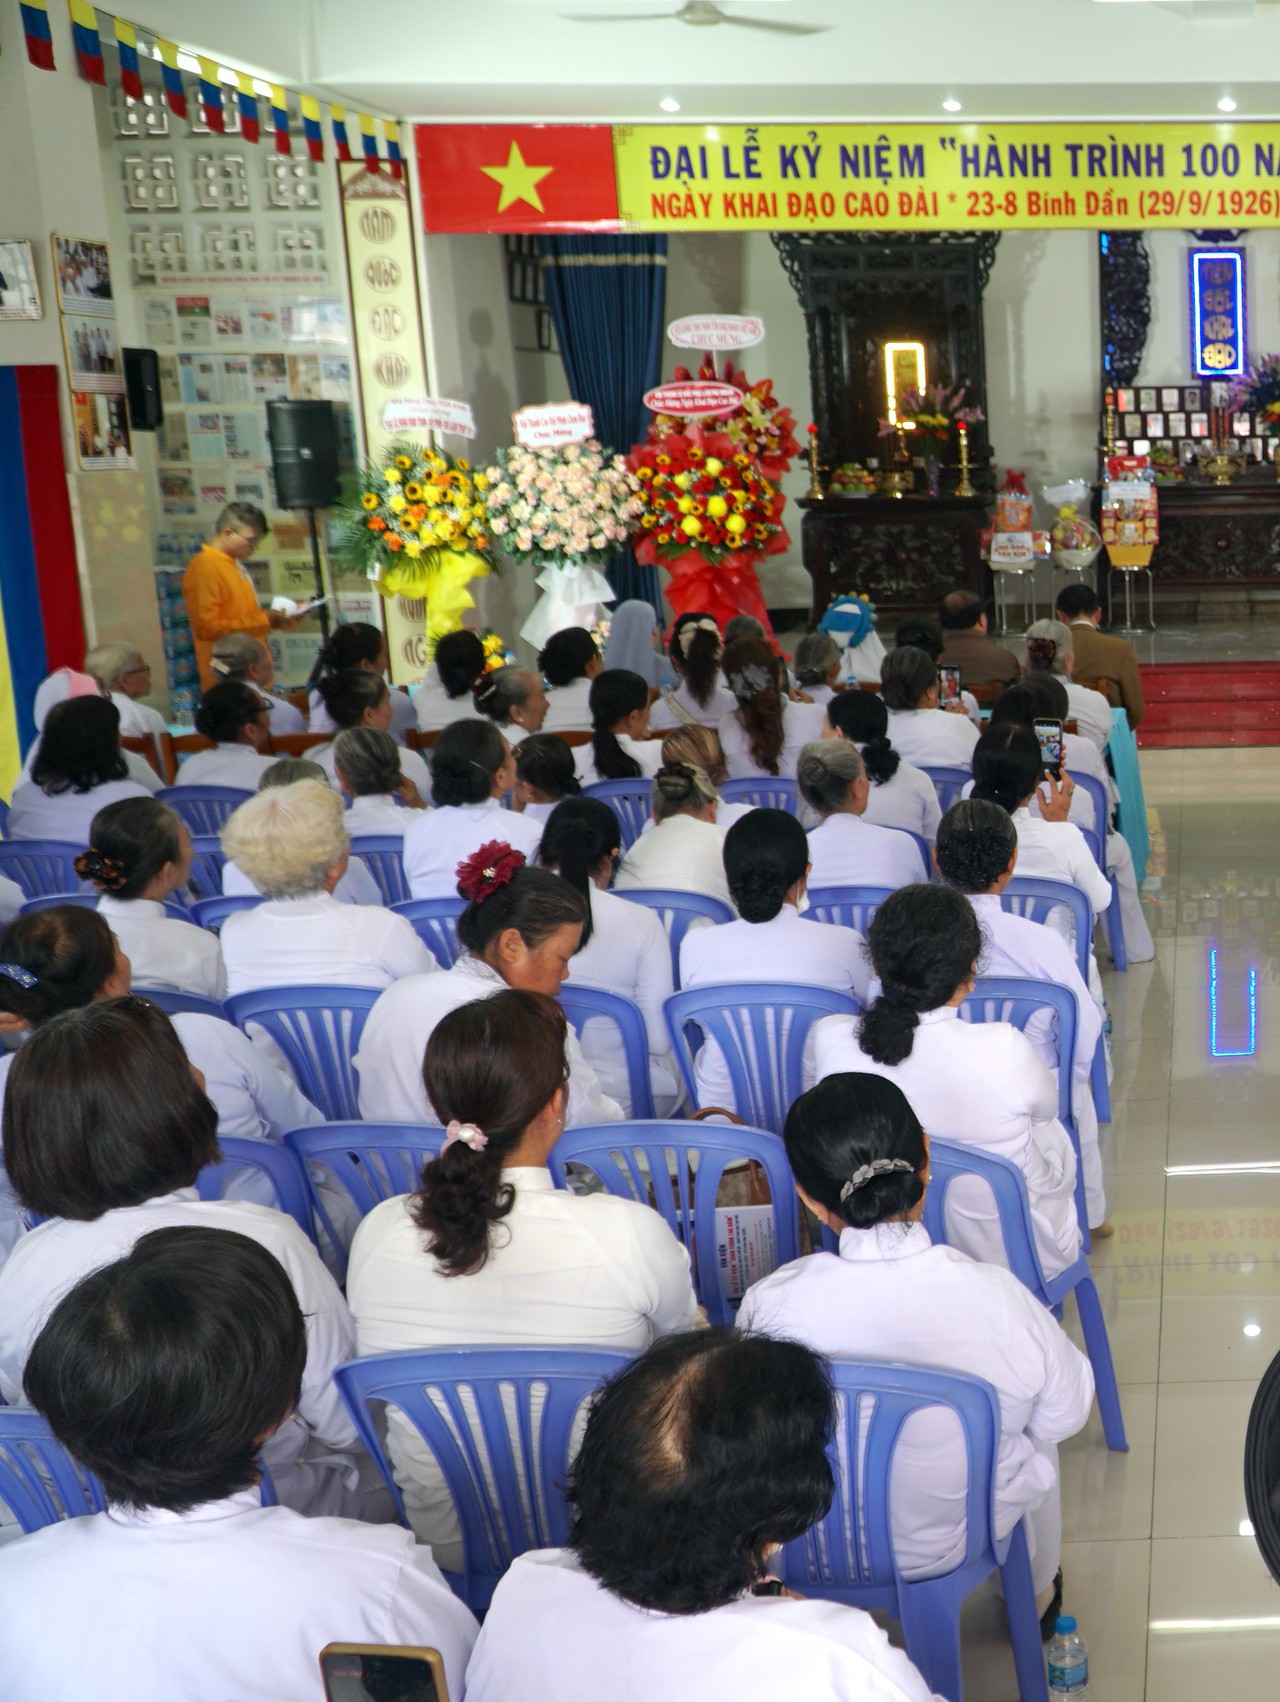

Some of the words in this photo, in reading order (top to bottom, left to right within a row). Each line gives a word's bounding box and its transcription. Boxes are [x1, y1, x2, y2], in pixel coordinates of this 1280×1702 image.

[649, 144, 708, 186] ĐẠI
[721, 128, 762, 179] LỄ
[778, 131, 822, 180] KỶ
[839, 134, 925, 186] NIỆM
[1065, 135, 1165, 178] TRÌNH
[1181, 143, 1240, 178] 100
[650, 186, 712, 219] NGÀY
[722, 192, 778, 218] KHAI
[786, 192, 836, 223] ĐẠO
[843, 191, 890, 217] CAO
[898, 185, 939, 218] ĐÀI
[966, 190, 1018, 217] 23-8
[1027, 190, 1076, 217] Bính
[1085, 187, 1129, 217] Dần
[1138, 189, 1280, 219] (29/9/1926)
